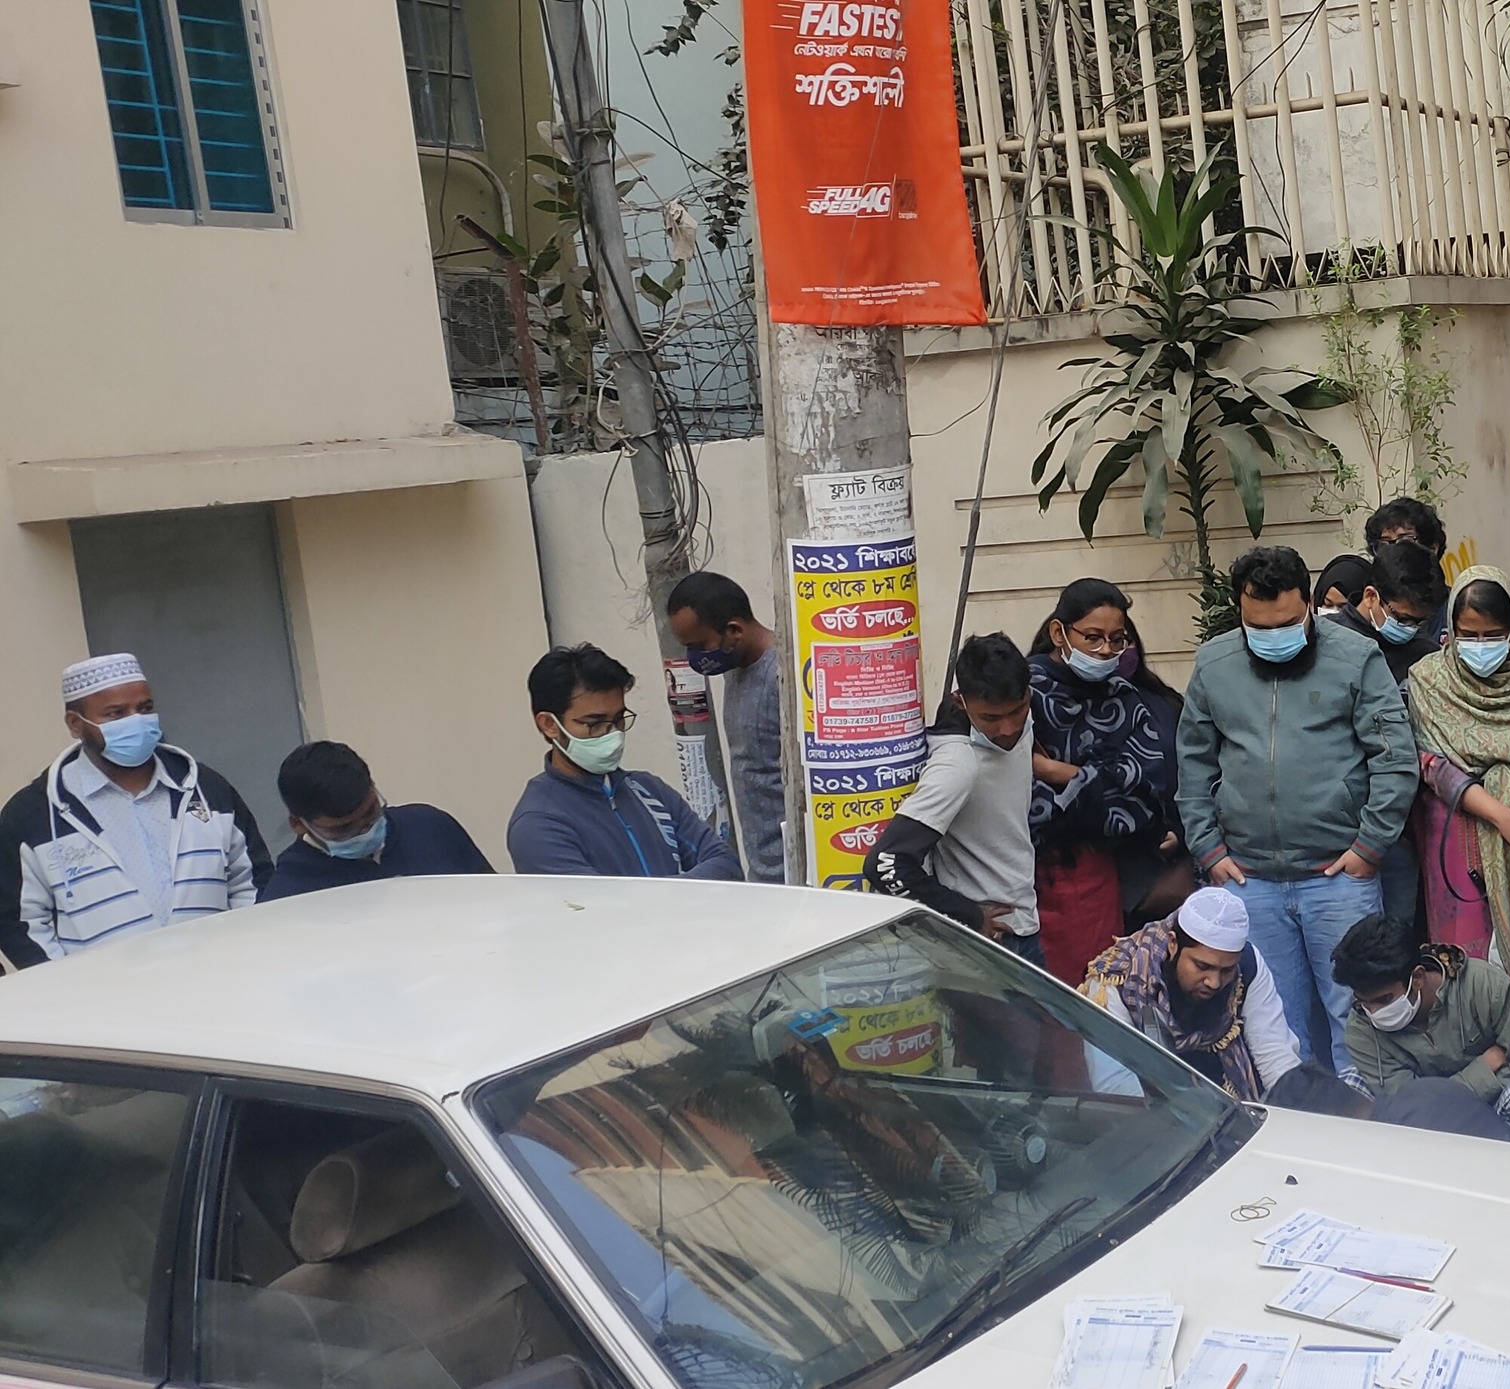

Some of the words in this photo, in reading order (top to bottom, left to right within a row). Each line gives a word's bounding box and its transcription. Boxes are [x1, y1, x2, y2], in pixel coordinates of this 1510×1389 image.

[824, 188, 862, 200] FULL
[860, 186, 890, 213] 4G
[808, 200, 861, 214] SPEED
[795, 552, 849, 572] ২০২১
[797, 579, 816, 600] প্লে
[823, 578, 866, 598] থেকে
[872, 576, 896, 594] ৮ম
[820, 605, 860, 631] ভর্তি
[824, 716, 878, 725] 01739-747587
[812, 774, 868, 793] ২০২১
[815, 800, 835, 820] প্লে
[842, 798, 885, 818] থেকে
[838, 823, 879, 850] ভর্তি
[858, 1010, 900, 1031] থেকে
[856, 1035, 893, 1061] ভর্তি
